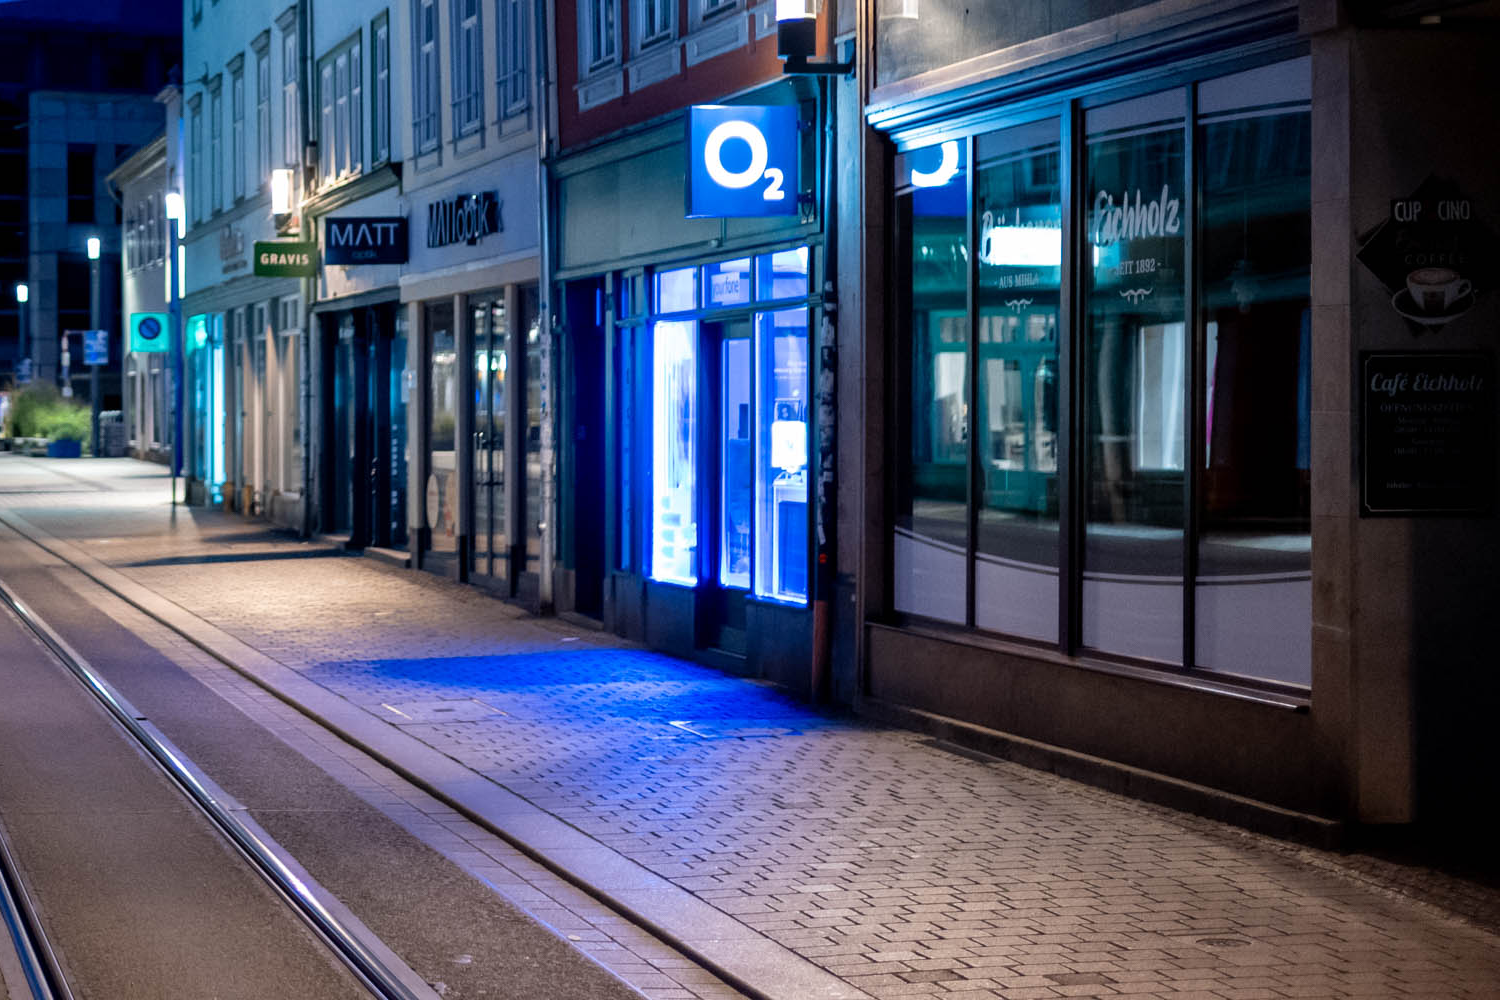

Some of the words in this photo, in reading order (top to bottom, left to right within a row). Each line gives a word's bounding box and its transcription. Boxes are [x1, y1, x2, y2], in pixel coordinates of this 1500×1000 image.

[1093, 184, 1181, 247] Eichholz
[1394, 200, 1422, 222] CUP
[1437, 200, 1471, 221] CINO
[331, 222, 399, 247] MATT
[260, 252, 309, 265] GRAVIS
[1135, 258, 1156, 274] 1892
[1370, 371, 1409, 398] Café
